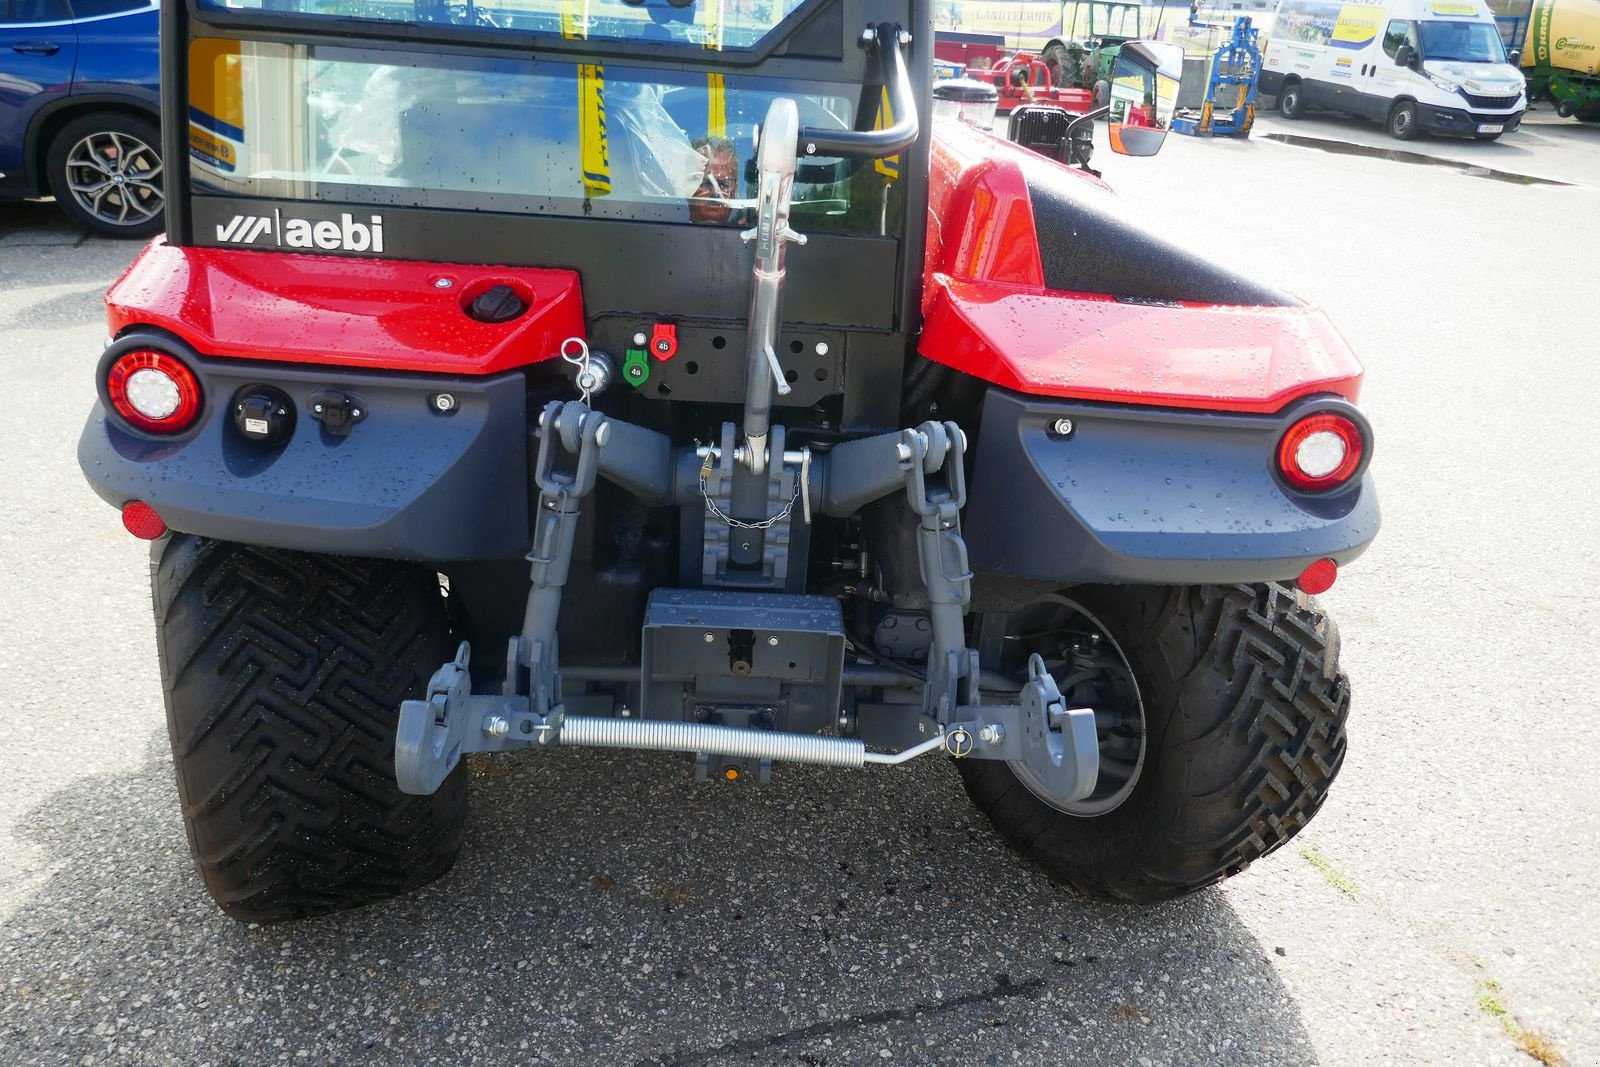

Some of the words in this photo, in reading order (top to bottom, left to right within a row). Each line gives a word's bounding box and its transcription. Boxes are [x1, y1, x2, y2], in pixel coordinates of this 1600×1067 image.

[976, 9, 1054, 22] LANDTECHNIK
[1555, 37, 1596, 51] Comprima
[285, 212, 384, 253] aebi
[659, 343, 669, 351] 4b
[632, 368, 641, 376] 4a
